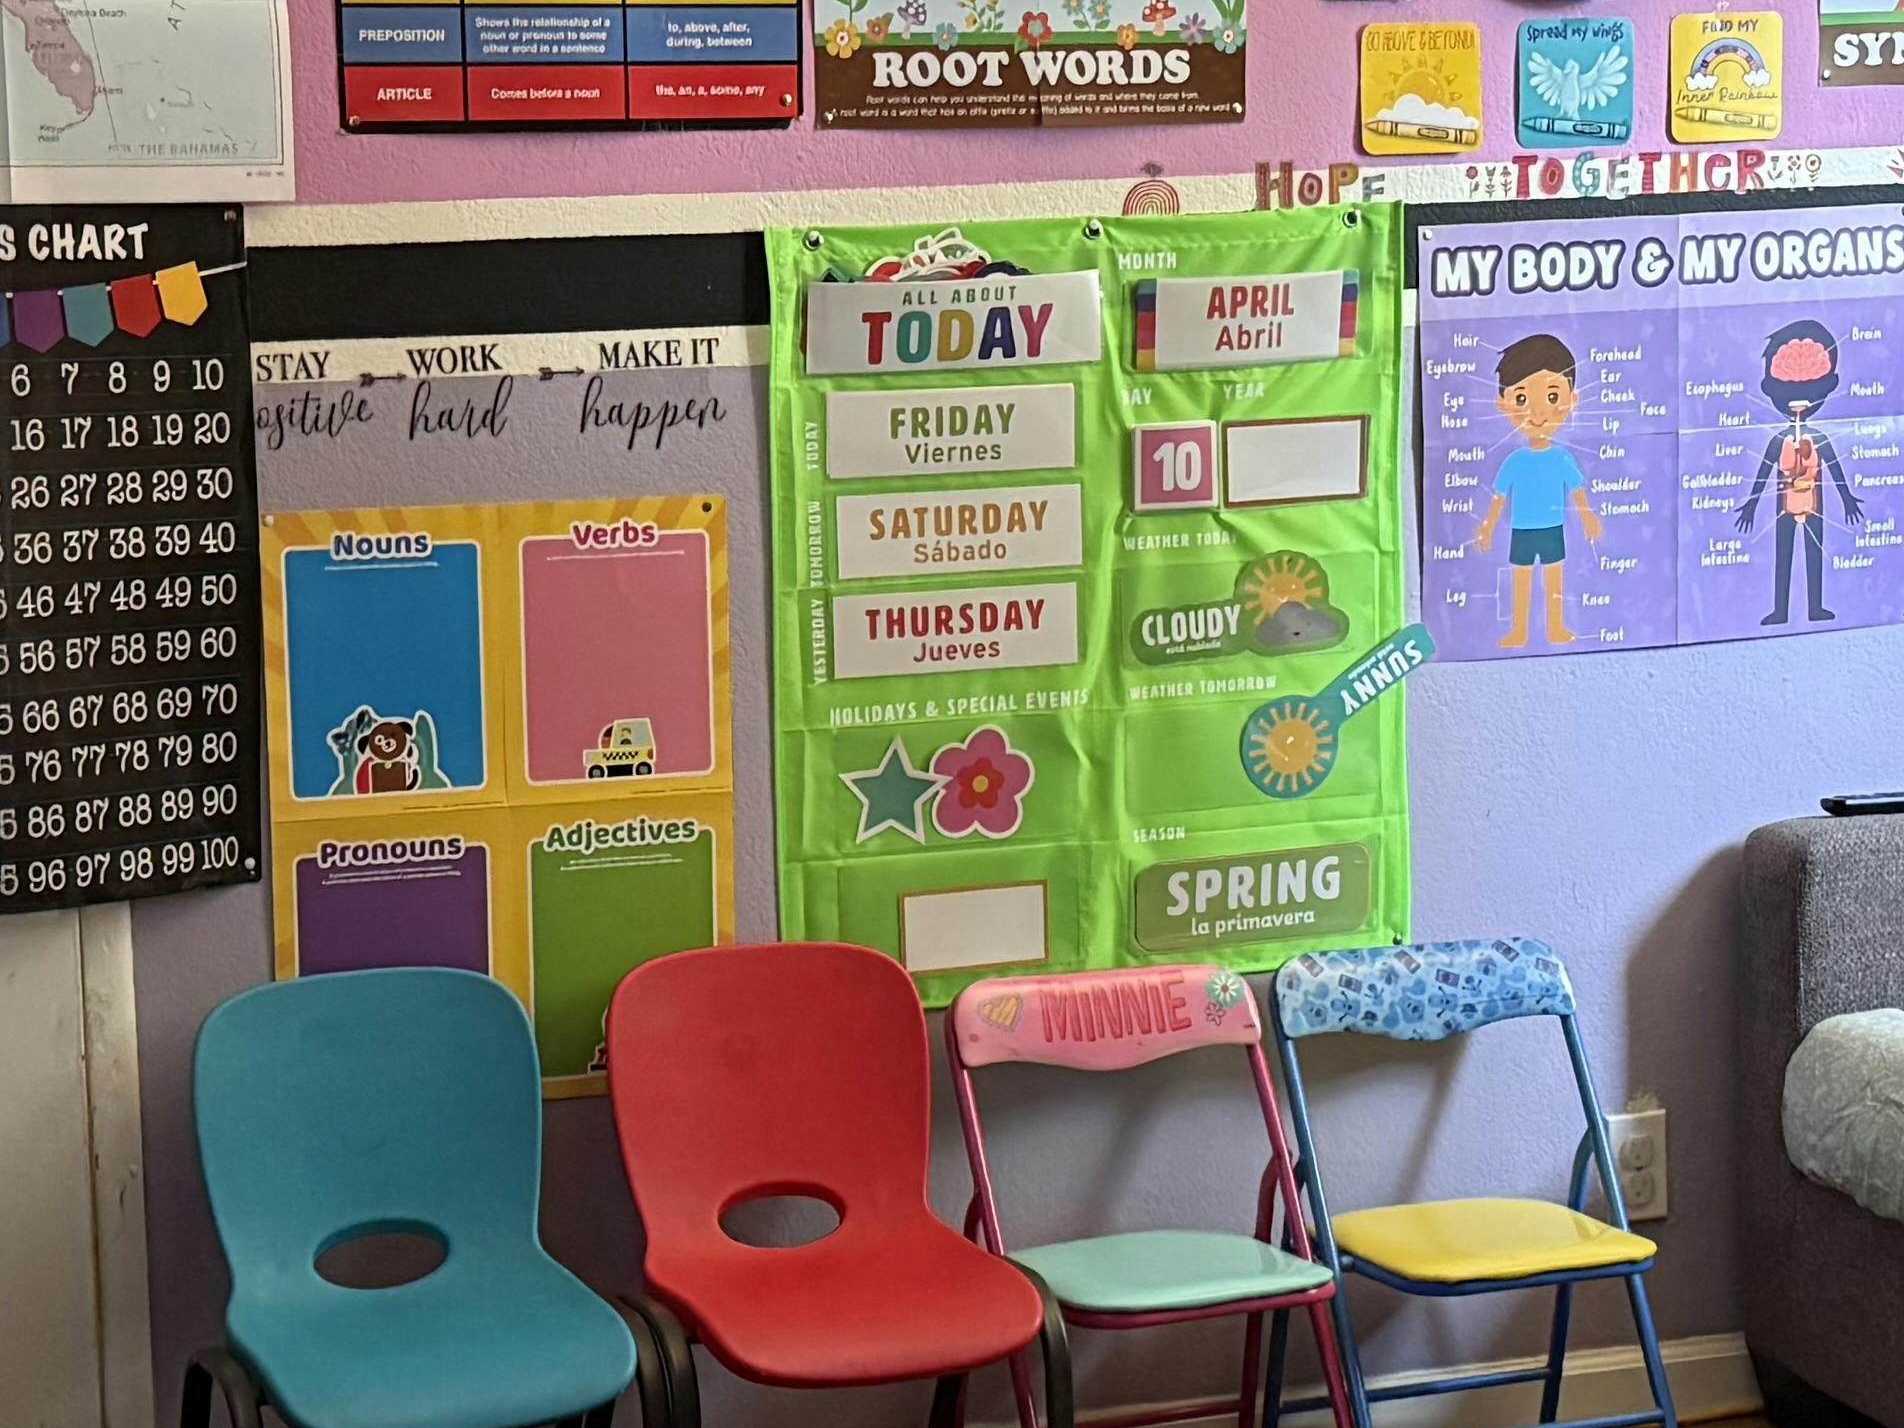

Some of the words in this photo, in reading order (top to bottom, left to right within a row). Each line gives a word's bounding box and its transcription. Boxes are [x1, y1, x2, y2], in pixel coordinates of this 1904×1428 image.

[359, 28, 444, 43] PREPOSITION
[873, 51, 1010, 88] ROOT
[1019, 49, 1191, 86] WORDS
[377, 86, 431, 101] ARTICLE
[1255, 161, 1386, 210] HOPE
[29, 223, 148, 261] CHART
[1118, 252, 1176, 270] MONTH
[1435, 249, 1498, 293] MY
[1513, 243, 1621, 287] BODY
[1637, 244, 1671, 283] &
[1684, 236, 1742, 280] MY
[903, 288, 942, 307] ALL
[951, 285, 1017, 304] ABOUT
[1207, 284, 1293, 320] APRIL
[862, 304, 1054, 365] TODAY
[1215, 321, 1282, 352] Abril
[1851, 327, 1882, 340] Brain
[256, 351, 330, 381] STAY
[406, 343, 501, 376] WORK
[599, 340, 682, 369] MAKE
[692, 338, 719, 365] IT
[1590, 347, 1642, 362] Forehead
[191, 359, 224, 391] 10
[257, 388, 373, 451] ositive
[410, 376, 513, 440] hard
[581, 377, 727, 450] happen
[890, 404, 1015, 439] FRIDAY
[1719, 412, 1750, 427] Heart
[806, 421, 818, 470] TODAY
[904, 441, 1001, 463] Viernes
[1153, 441, 1201, 492] 10
[572, 521, 656, 545] Verbs
[870, 501, 1048, 540] SATURDAY
[333, 534, 429, 556] Nouns
[809, 500, 823, 587] TOMORROW
[914, 539, 1007, 563] Sábado
[1124, 534, 1189, 550] WEATHER
[201, 574, 237, 605] 50
[865, 598, 1045, 639] THURSDAY
[1141, 605, 1240, 646] CLOUDY
[814, 598, 827, 684] YESTERDAY
[913, 638, 1000, 662] Jueves
[1130, 681, 1193, 700] WEATHER
[1201, 676, 1277, 695] TOMORROW
[1339, 637, 1421, 716] SUNNY
[830, 702, 916, 725] HOLIDAYS
[926, 701, 938, 717] &
[947, 693, 1016, 715] SPECIAL
[1026, 689, 1089, 708] EVENTS
[319, 837, 462, 865] Pronouns
[546, 819, 695, 852] Adjectives
[1133, 827, 1184, 842] SEASON
[201, 837, 238, 869] 100
[1166, 856, 1341, 916] SPRING
[1192, 915, 1209, 936] la
[1215, 908, 1315, 937] primavera
[1040, 973, 1190, 1043] MINNIE
